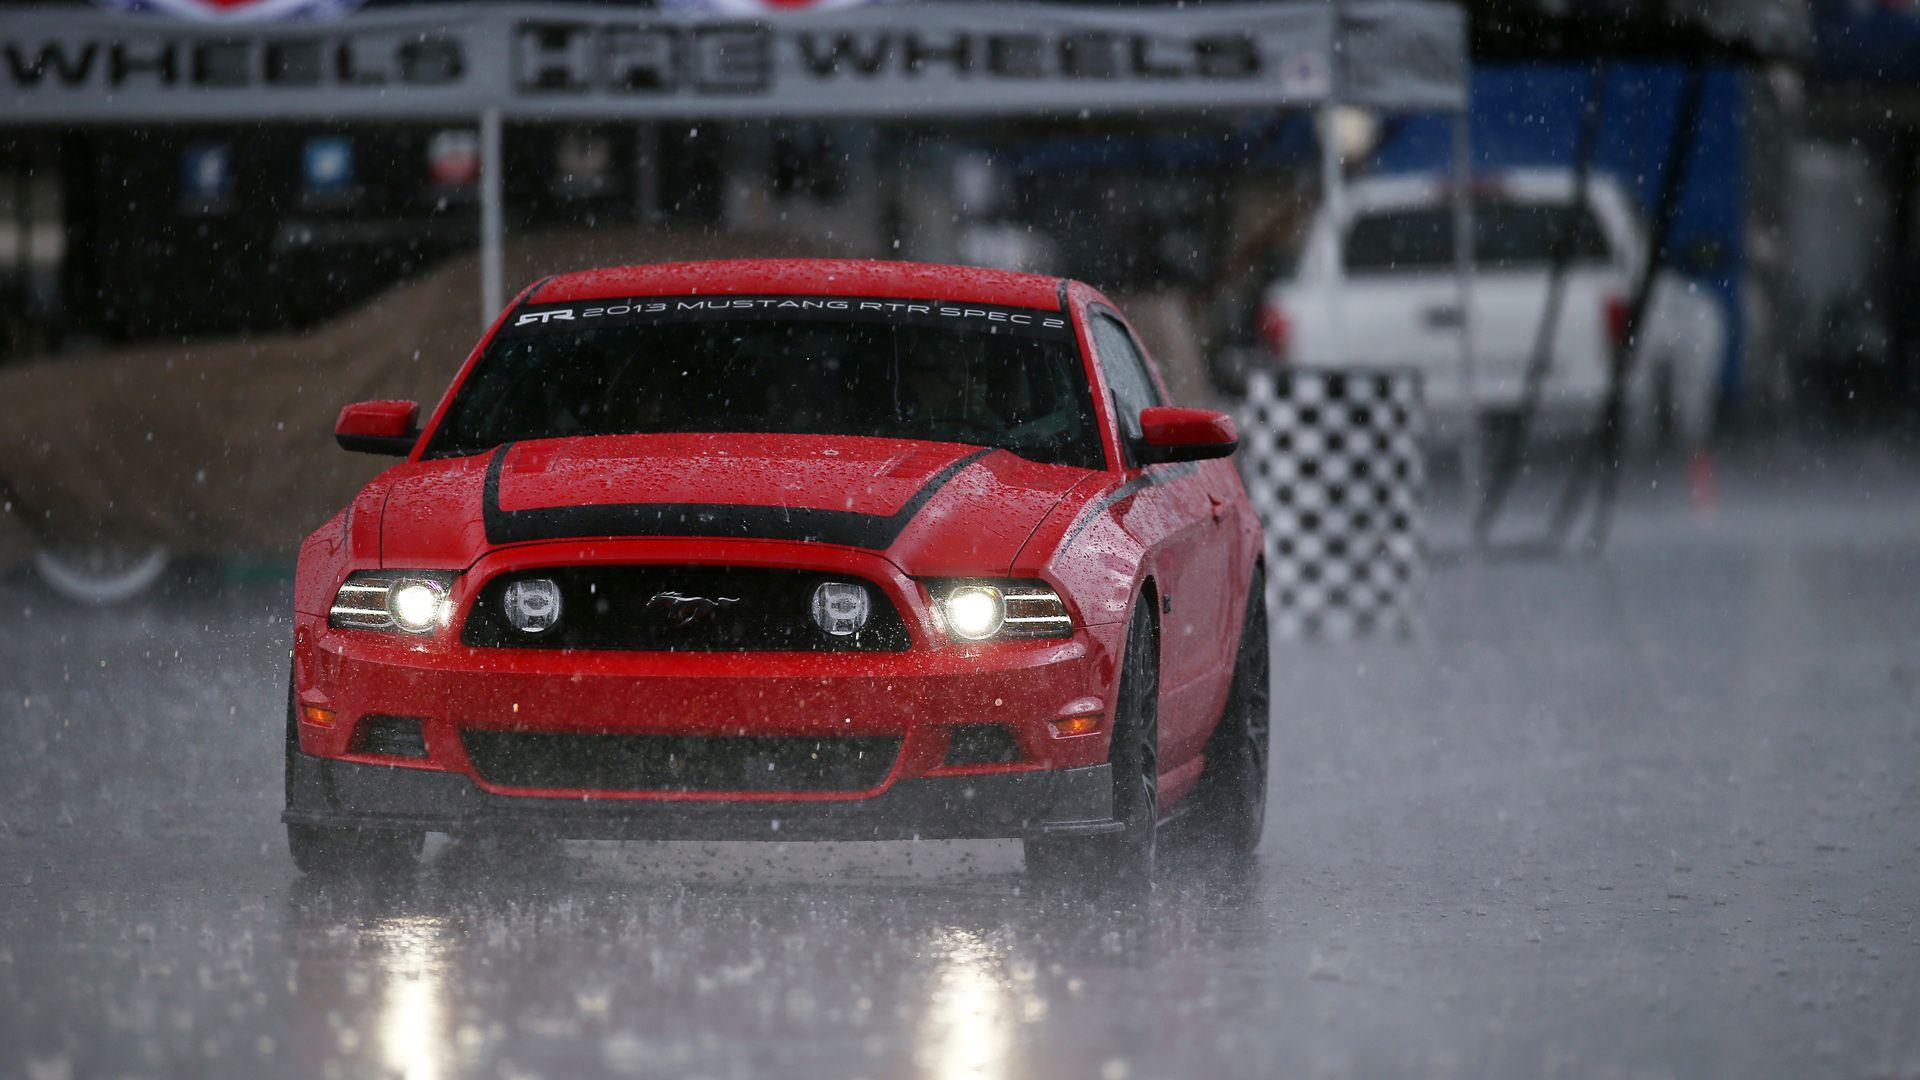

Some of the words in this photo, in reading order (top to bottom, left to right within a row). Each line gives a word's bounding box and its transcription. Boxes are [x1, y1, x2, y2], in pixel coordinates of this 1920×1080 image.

[5, 37, 465, 88] WHEELS
[799, 29, 1262, 79] WHEELS
[582, 302, 667, 318] 2013
[677, 299, 849, 311] MUSTANG
[859, 301, 930, 315] RTR
[940, 306, 1032, 325] SPEC
[1042, 317, 1065, 329] 2
